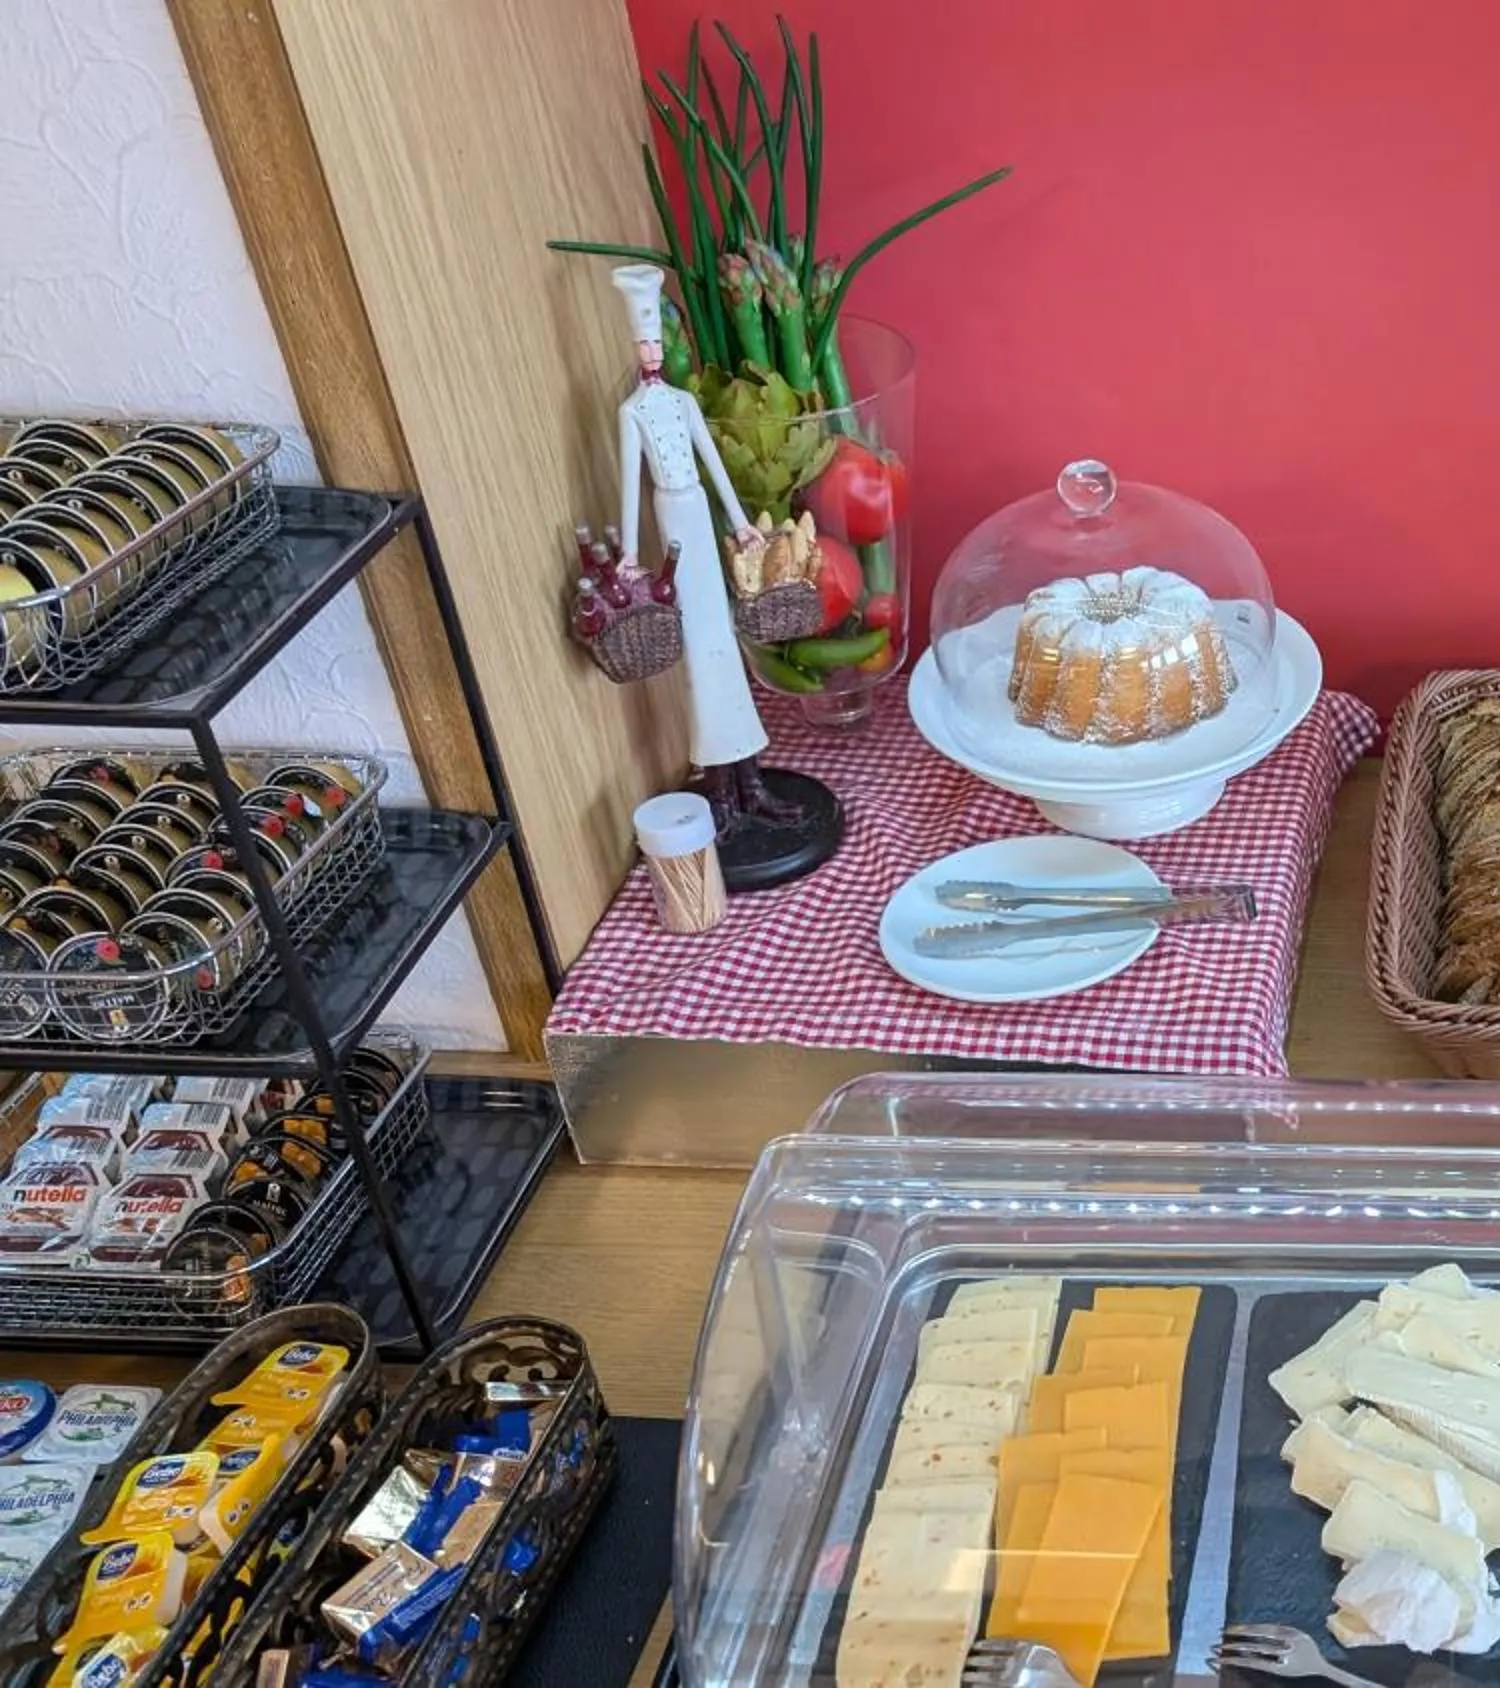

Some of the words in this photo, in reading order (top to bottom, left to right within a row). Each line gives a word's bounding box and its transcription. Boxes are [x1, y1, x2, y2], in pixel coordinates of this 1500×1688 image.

[13, 1186, 86, 1203] nutella
[114, 1197, 184, 1214] nutella
[56, 1409, 138, 1427] PHILADELPHIA
[0, 1491, 75, 1510] HILADELPHIA
